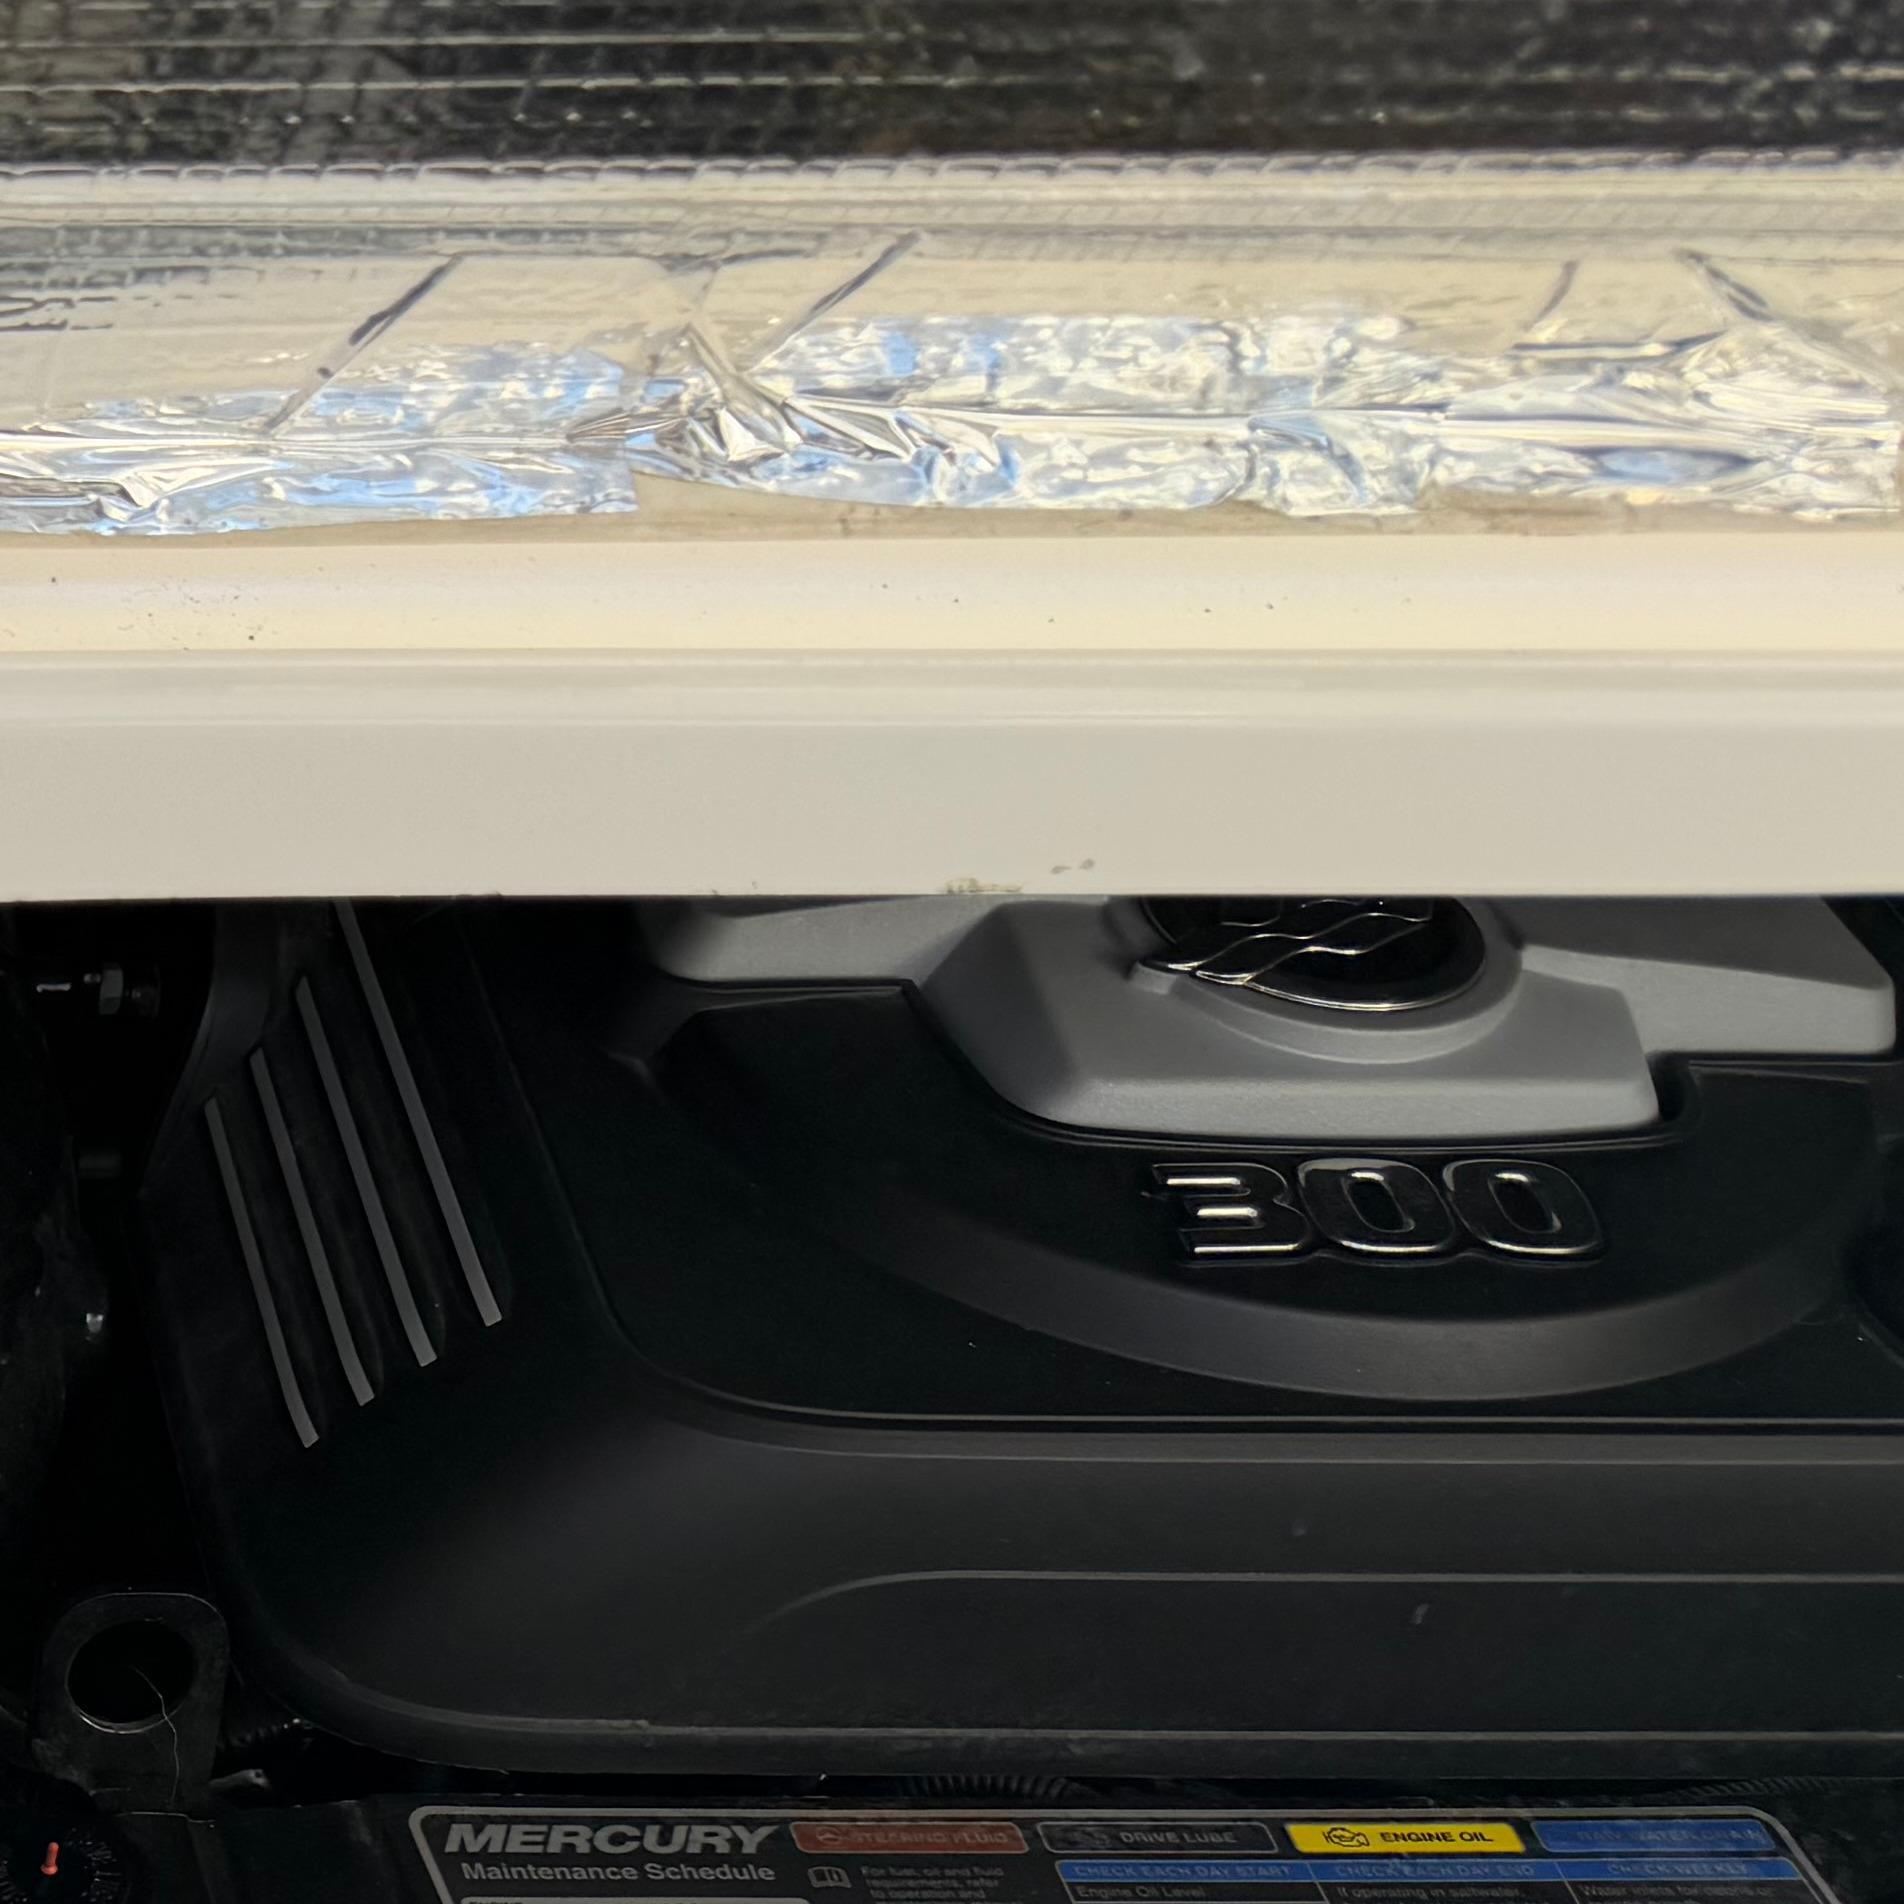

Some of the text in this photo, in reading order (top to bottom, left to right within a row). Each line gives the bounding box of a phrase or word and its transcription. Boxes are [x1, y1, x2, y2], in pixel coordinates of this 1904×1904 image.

[1150, 1159, 1602, 1266] 300
[444, 1823, 779, 1855] MERCURY
[1120, 1833, 1237, 1843] DRIVE LUBE
[1381, 1833, 1493, 1843] ENGINE OIL
[462, 1862, 776, 1881] Maintenance Schedule
